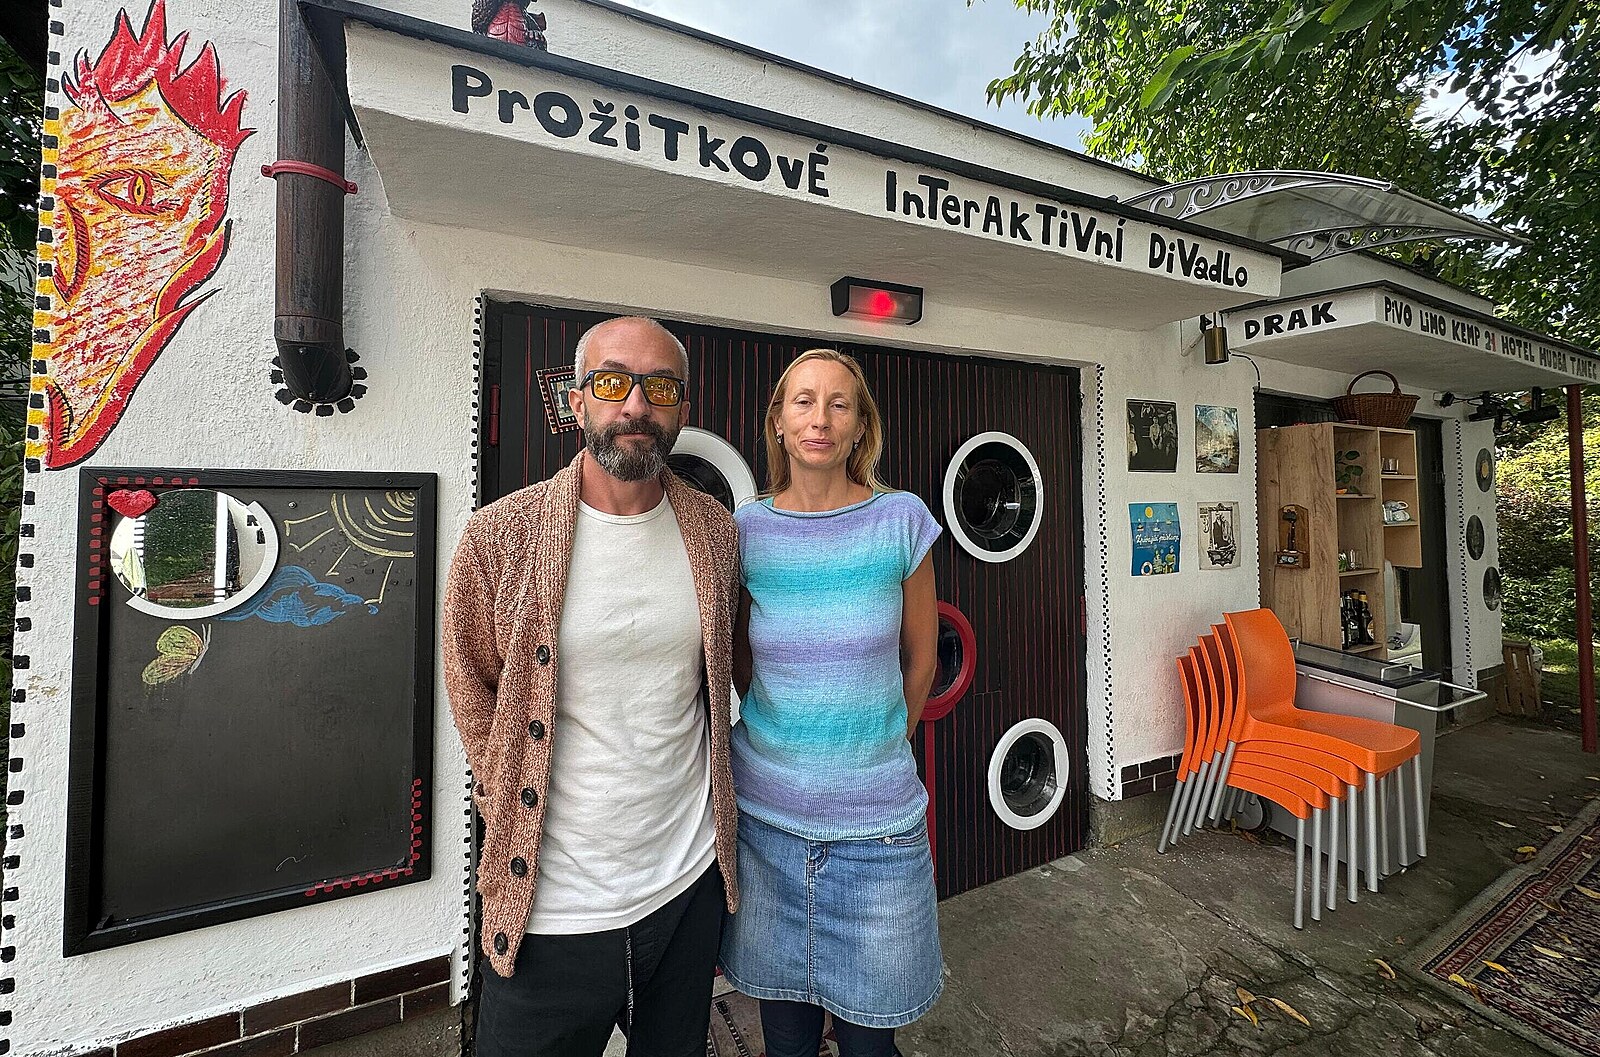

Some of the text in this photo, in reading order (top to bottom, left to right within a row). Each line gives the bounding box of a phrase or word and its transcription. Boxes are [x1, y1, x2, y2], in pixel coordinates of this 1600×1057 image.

[1244, 301, 1337, 340] DRAK
[1451, 319, 1480, 346] KEMP
[1500, 335, 1535, 362] HOTEL
